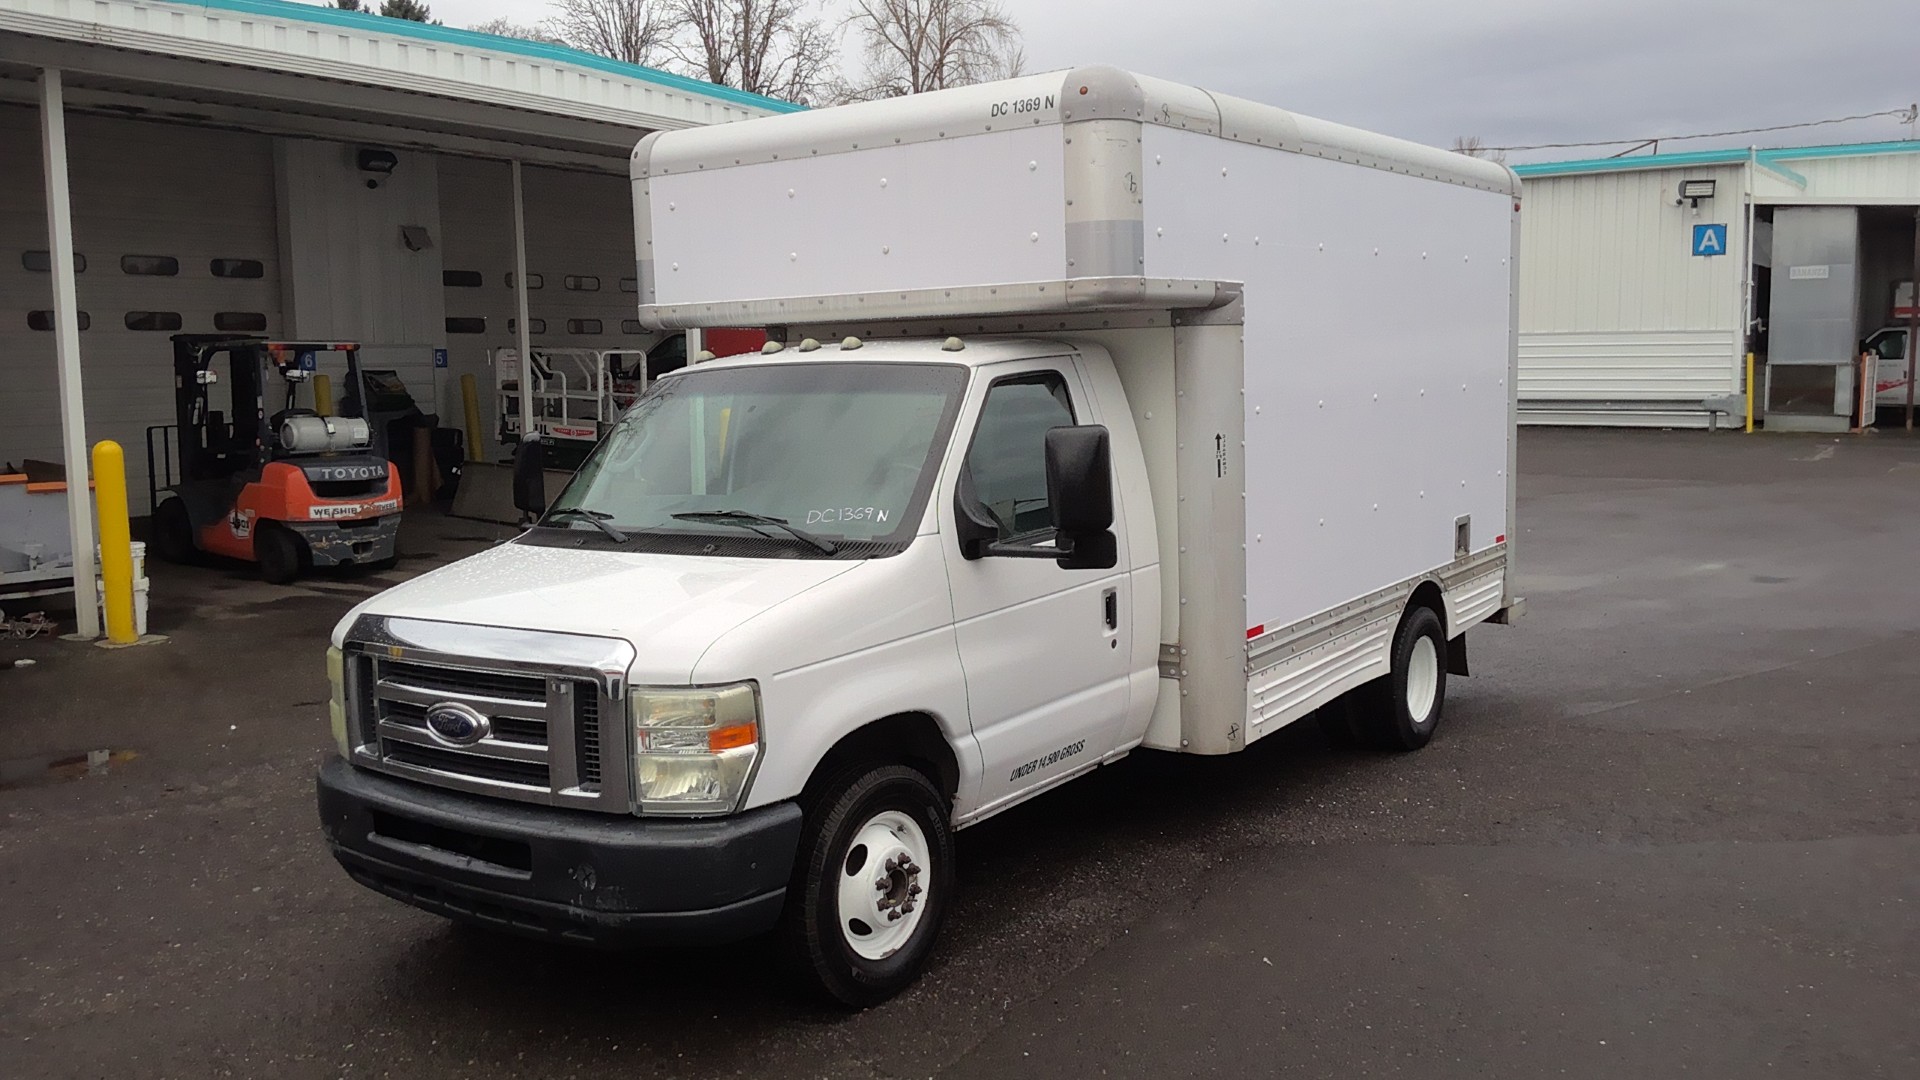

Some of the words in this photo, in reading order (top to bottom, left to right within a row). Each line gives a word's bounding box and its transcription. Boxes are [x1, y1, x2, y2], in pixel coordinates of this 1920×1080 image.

[991, 101, 1008, 117] DC
[1012, 97, 1041, 113] 1369
[1044, 94, 1055, 109] N
[1698, 228, 1720, 251] A
[304, 354, 313, 368] 6
[436, 352, 443, 365] 5
[321, 465, 385, 479] TOYOTA
[1010, 759, 1038, 782] UNDER
[1060, 739, 1086, 760] GROSS
